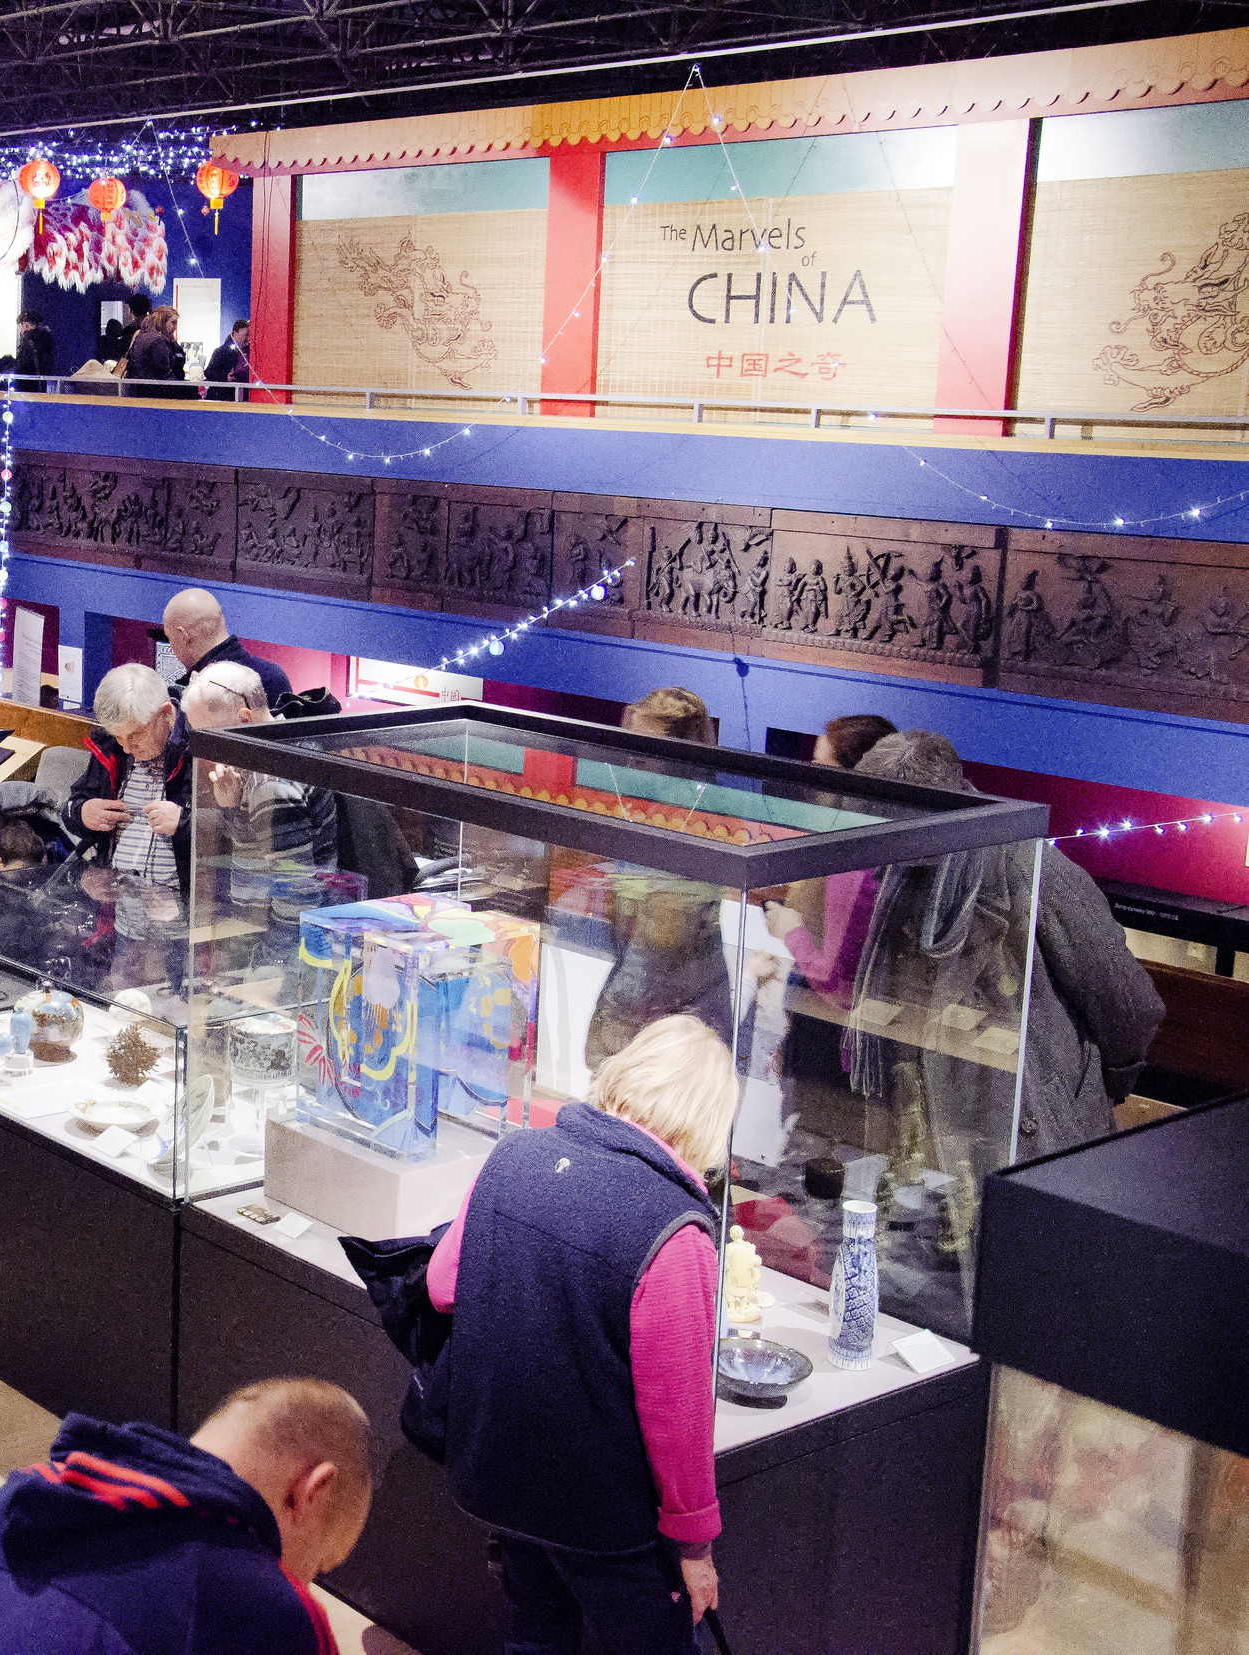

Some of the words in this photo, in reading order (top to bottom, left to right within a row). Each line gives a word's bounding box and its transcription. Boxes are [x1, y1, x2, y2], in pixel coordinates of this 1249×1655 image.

[660, 224, 687, 241] The
[691, 218, 806, 252] Marvels
[801, 251, 818, 267] of
[688, 270, 877, 324] CHINA
[705, 350, 848, 381] 中国之奇
